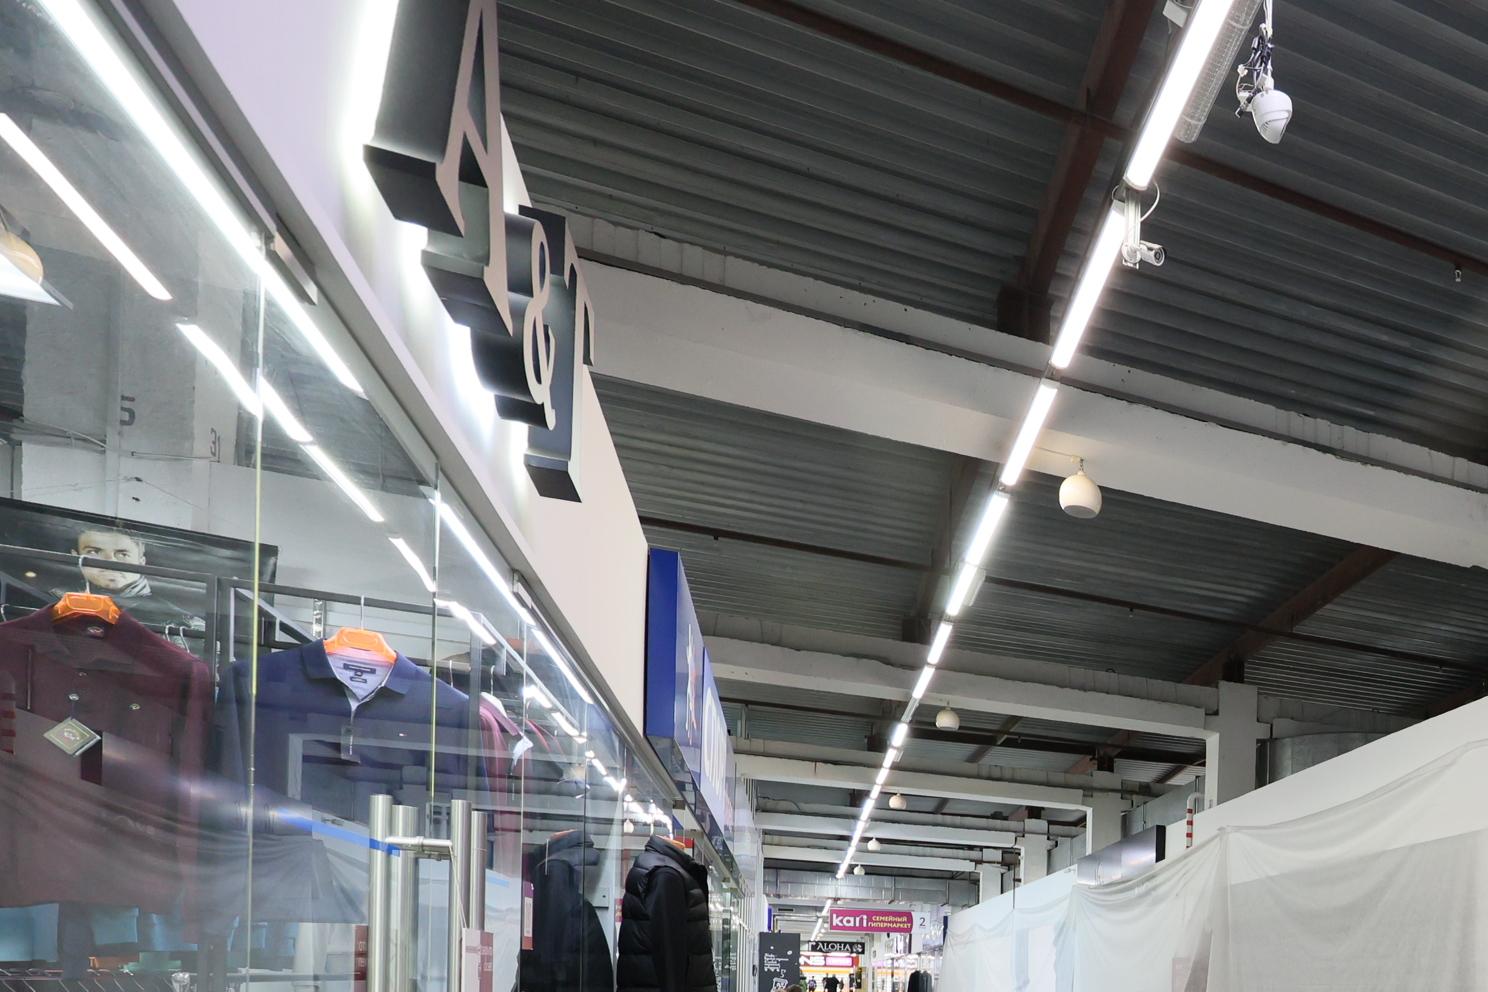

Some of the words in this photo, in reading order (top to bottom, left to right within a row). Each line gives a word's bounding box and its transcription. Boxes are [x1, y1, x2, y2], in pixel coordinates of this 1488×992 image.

[832, 914, 867, 928] kari
[868, 921, 912, 929] ГИПЕРМАРКЕТ
[919, 917, 926, 927] 2
[816, 942, 851, 952] ALOHA
